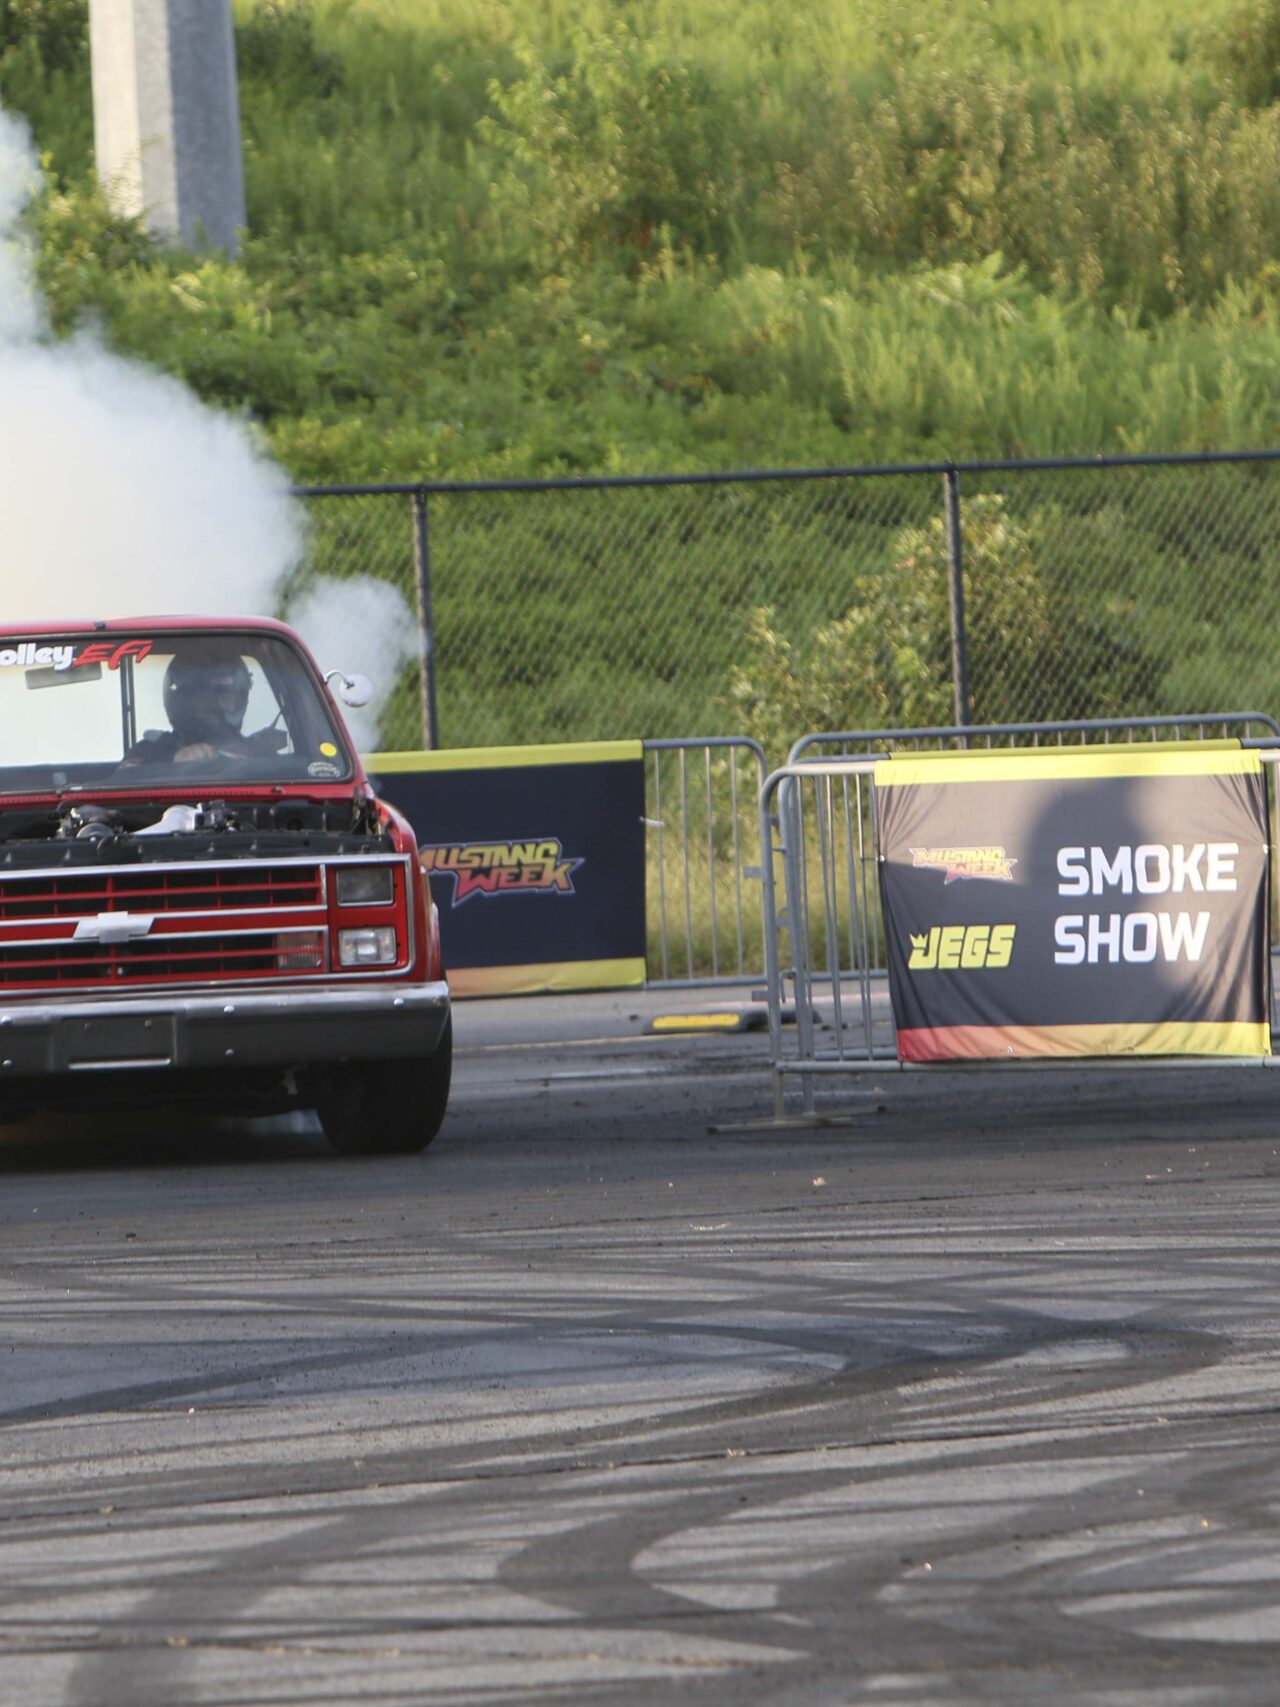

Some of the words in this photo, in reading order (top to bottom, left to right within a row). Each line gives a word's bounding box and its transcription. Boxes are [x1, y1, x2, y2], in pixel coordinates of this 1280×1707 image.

[72, 640, 154, 670] EFI
[909, 848, 1006, 867] MUSTANG
[945, 861, 1014, 883] WEEK
[1056, 842, 1240, 896] SMOKE
[456, 862, 573, 898] WEEK
[908, 924, 1016, 969] JEGS
[1054, 911, 1211, 965] SHOW
